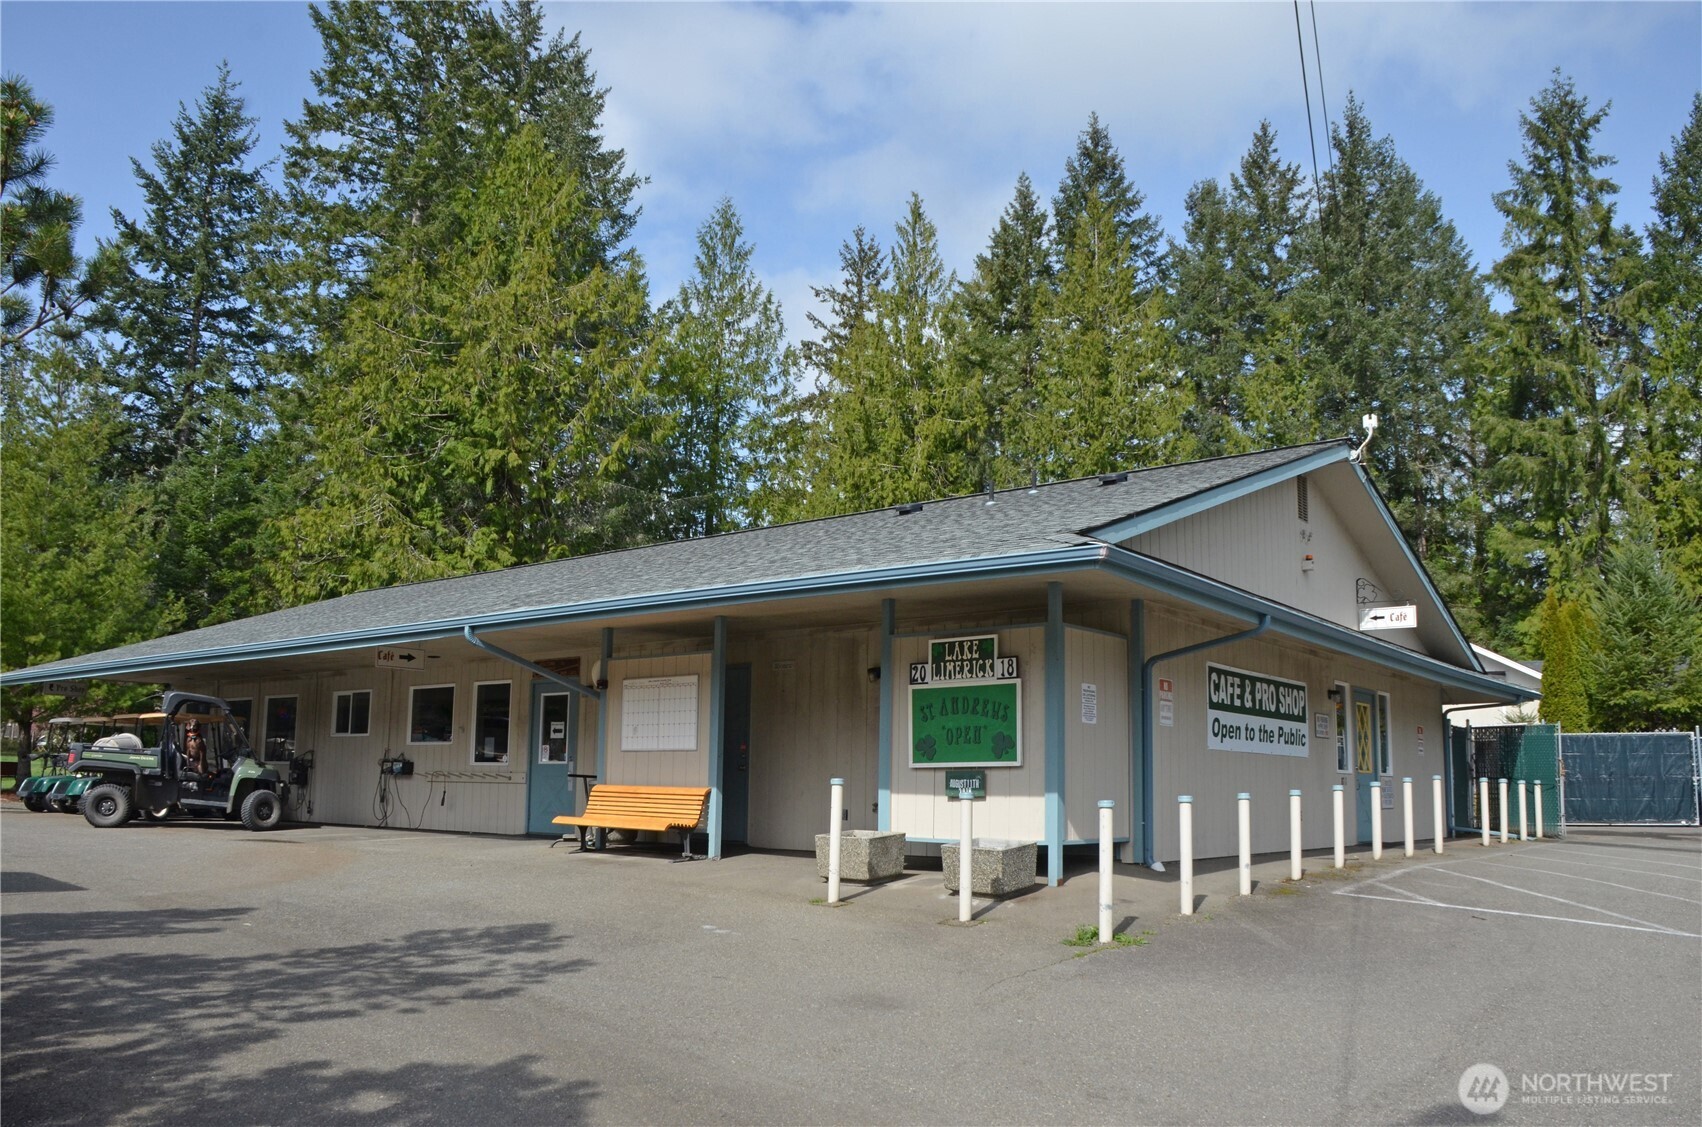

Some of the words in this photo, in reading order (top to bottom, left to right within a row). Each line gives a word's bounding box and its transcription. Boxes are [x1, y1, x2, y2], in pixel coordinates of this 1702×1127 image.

[945, 641, 979, 660] LAKE
[912, 665, 927, 682] 20
[932, 659, 994, 681] LIMERICK
[1000, 659, 1014, 677] 18
[1210, 672, 1241, 707] CAFE
[1244, 679, 1252, 709] &
[1255, 682, 1277, 712] PRO
[1279, 686, 1305, 717] SHOP
[920, 703, 936, 722] ST
[940, 696, 1010, 722] ANDREWS
[1212, 717, 1241, 744] Open
[1245, 723, 1255, 742] to
[1259, 724, 1275, 743] the
[1278, 726, 1306, 747] Public
